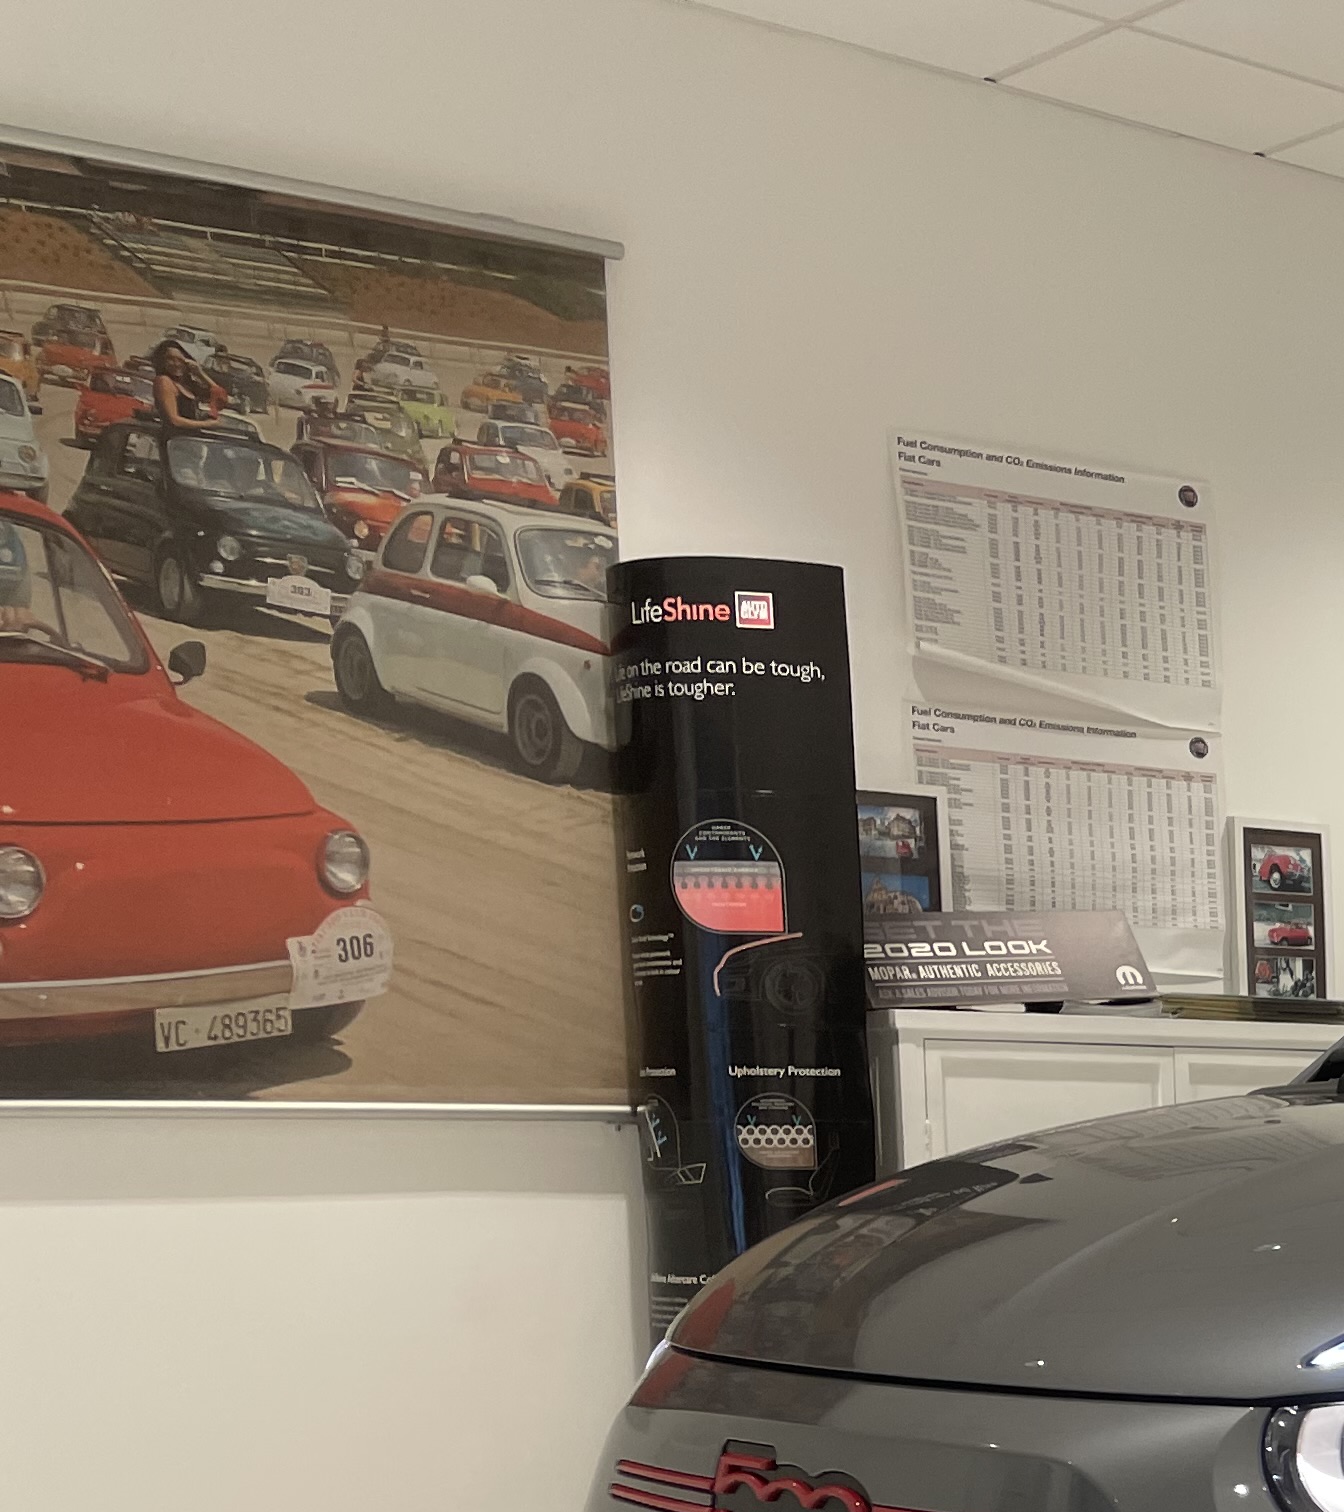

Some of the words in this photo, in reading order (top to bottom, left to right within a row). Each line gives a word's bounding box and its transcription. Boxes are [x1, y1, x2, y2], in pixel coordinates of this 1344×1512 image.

[897, 436, 918, 449] Fuel
[919, 440, 984, 460] Consumption
[986, 453, 1003, 464] and
[1026, 459, 1072, 476] Emissions
[1074, 466, 1125, 484] Information
[918, 454, 941, 468] Cars
[631, 595, 731, 625] LifeShine
[640, 658, 662, 676] the
[665, 656, 702, 674] road
[706, 661, 737, 674] can
[742, 657, 766, 675] be
[770, 660, 825, 683] tough,
[654, 679, 665, 697] is
[668, 678, 736, 700] tougher.
[911, 705, 932, 718] Fuel
[933, 708, 997, 724] Consumption
[999, 716, 1017, 727] and
[1039, 720, 1085, 734] Emissions
[1086, 726, 1137, 739] Information
[932, 722, 955, 734] Cars
[952, 918, 1045, 939] THE
[336, 933, 375, 963] 306
[864, 941, 957, 959] 2020
[961, 939, 1053, 957] LOOK
[919, 963, 982, 979] AUTHENTIC
[986, 961, 1062, 978] ACCESSORIES
[160, 1019, 188, 1049] VC
[728, 1065, 786, 1079] Upholstery
[787, 1065, 841, 1077] Protection
